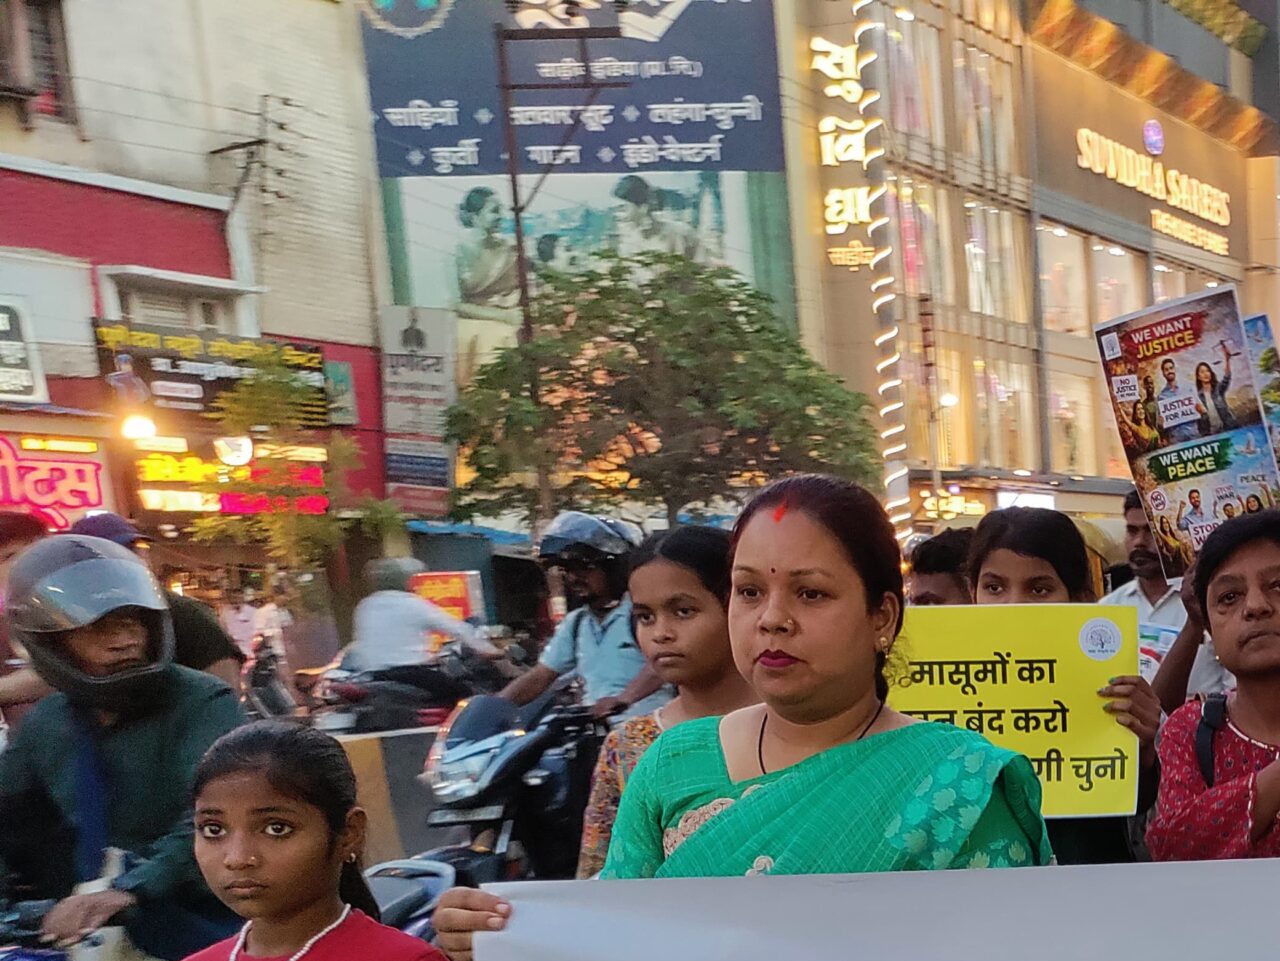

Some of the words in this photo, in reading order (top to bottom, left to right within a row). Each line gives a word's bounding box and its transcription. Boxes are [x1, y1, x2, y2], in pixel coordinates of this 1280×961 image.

[1077, 128, 1167, 200] SUVIDHA
[1166, 169, 1231, 226] SAREES
[1131, 328, 1152, 344] WE
[1152, 317, 1192, 337] WANT
[1136, 330, 1196, 359] JUSTICE
[1115, 385, 1137, 394] JUSTICE
[1119, 378, 1131, 386] NO
[1161, 396, 1195, 414] JUSTICE
[1164, 411, 1180, 422] FOR
[1180, 408, 1195, 418] ALL
[1158, 450, 1179, 467] WE
[1179, 441, 1221, 461] WANT
[1166, 456, 1217, 480] PEACE
[1240, 474, 1266, 483] PEACE
[1215, 492, 1235, 501] WAR
[909, 651, 1012, 696] मासूमों
[1015, 658, 1057, 684] का
[963, 701, 1005, 735] बंद
[1011, 700, 1069, 733] करो
[1070, 747, 1128, 792] चुनो
